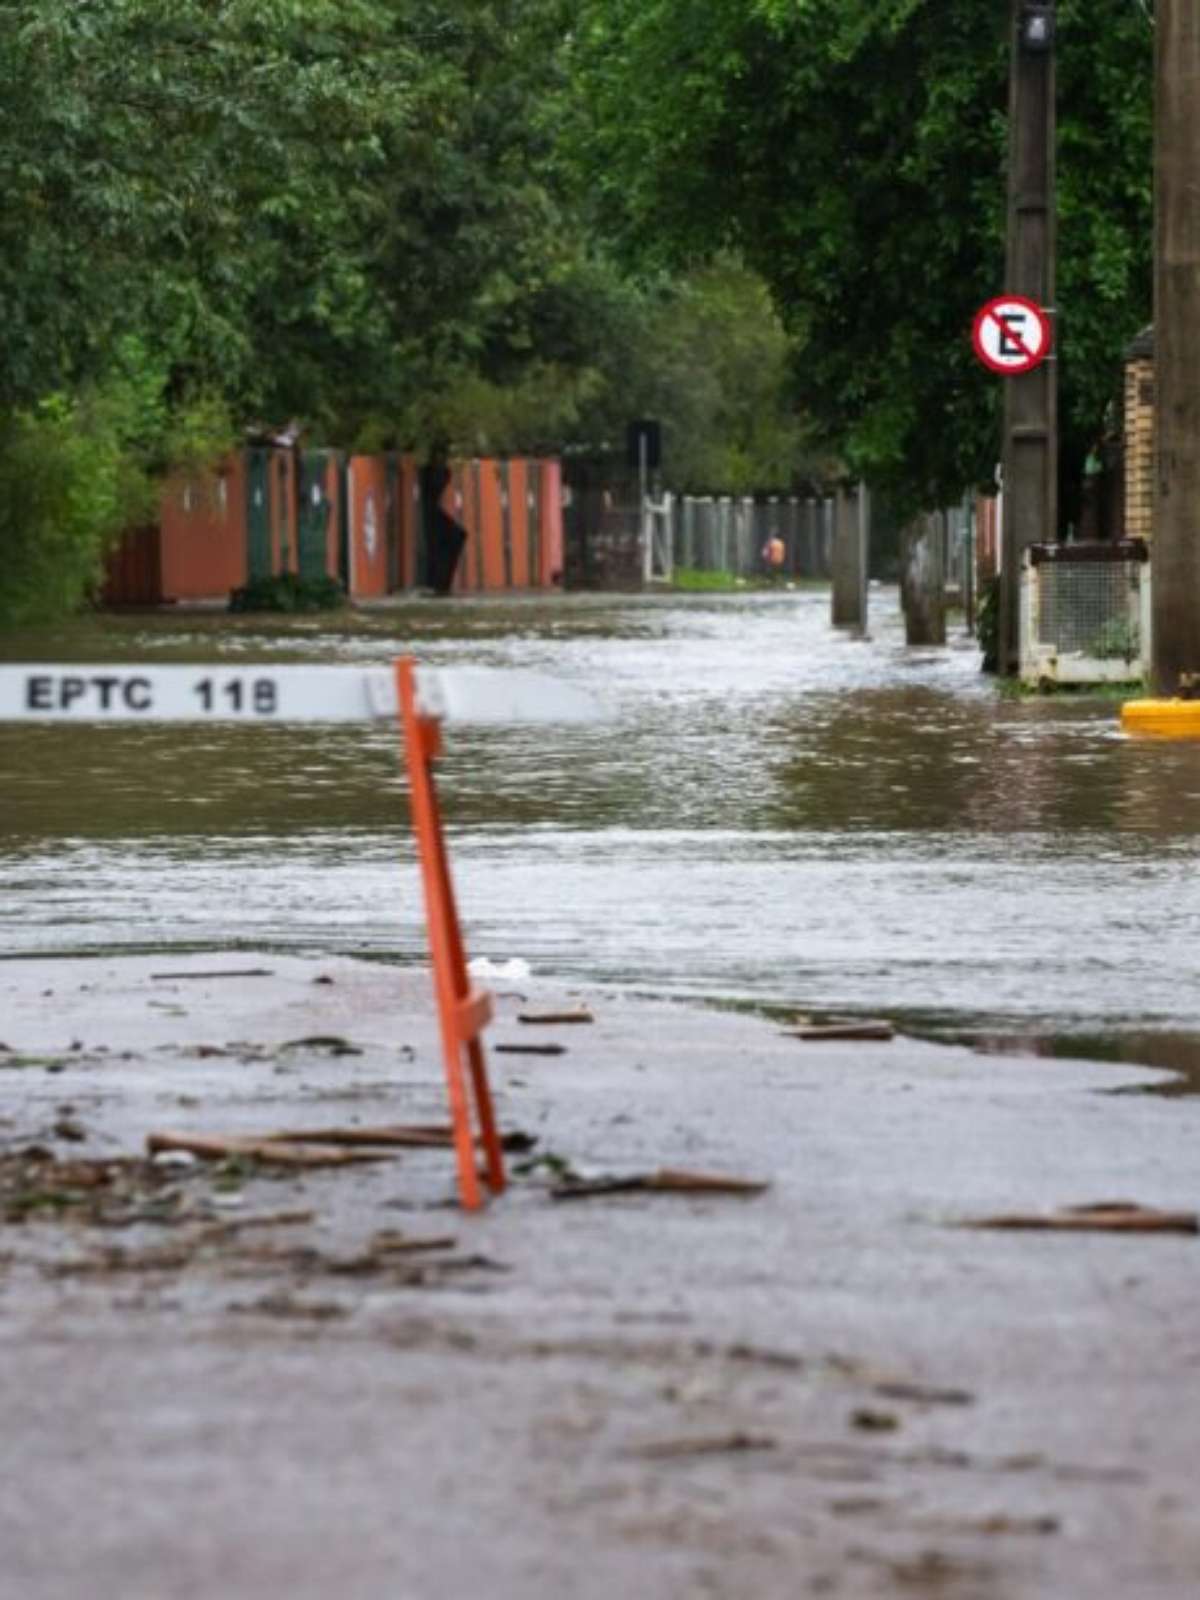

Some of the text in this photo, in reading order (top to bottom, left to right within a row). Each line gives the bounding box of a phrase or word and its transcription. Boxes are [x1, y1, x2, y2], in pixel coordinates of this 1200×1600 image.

[999, 314, 1027, 356] E
[26, 676, 278, 714] EPTC 118
